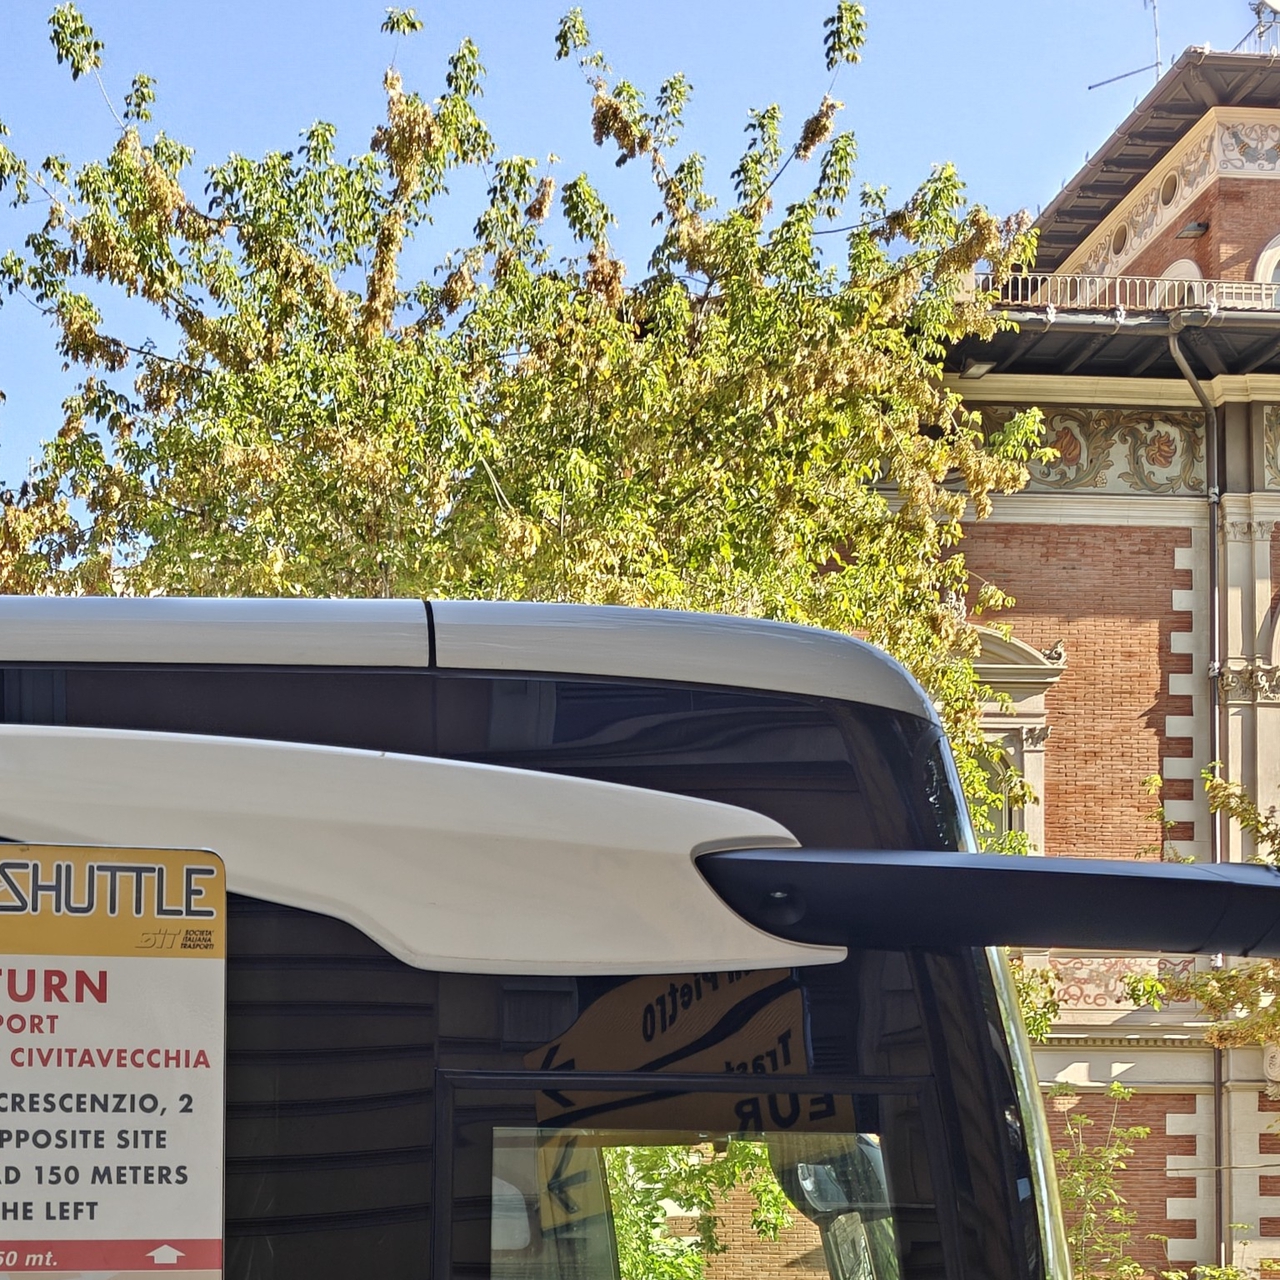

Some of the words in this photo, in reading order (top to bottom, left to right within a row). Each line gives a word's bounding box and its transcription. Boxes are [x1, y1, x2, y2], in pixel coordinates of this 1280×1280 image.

[180, 942, 214, 950] TRASPORTI
[11, 1048, 210, 1068] CIVITAVECCHIA
[179, 1094, 192, 1113] 2
[117, 1130, 166, 1149] SITE
[35, 1166, 79, 1185] 150
[91, 1166, 187, 1184] METERS
[46, 1202, 98, 1220] LEFT
[25, 1251, 58, 1267] mt.
